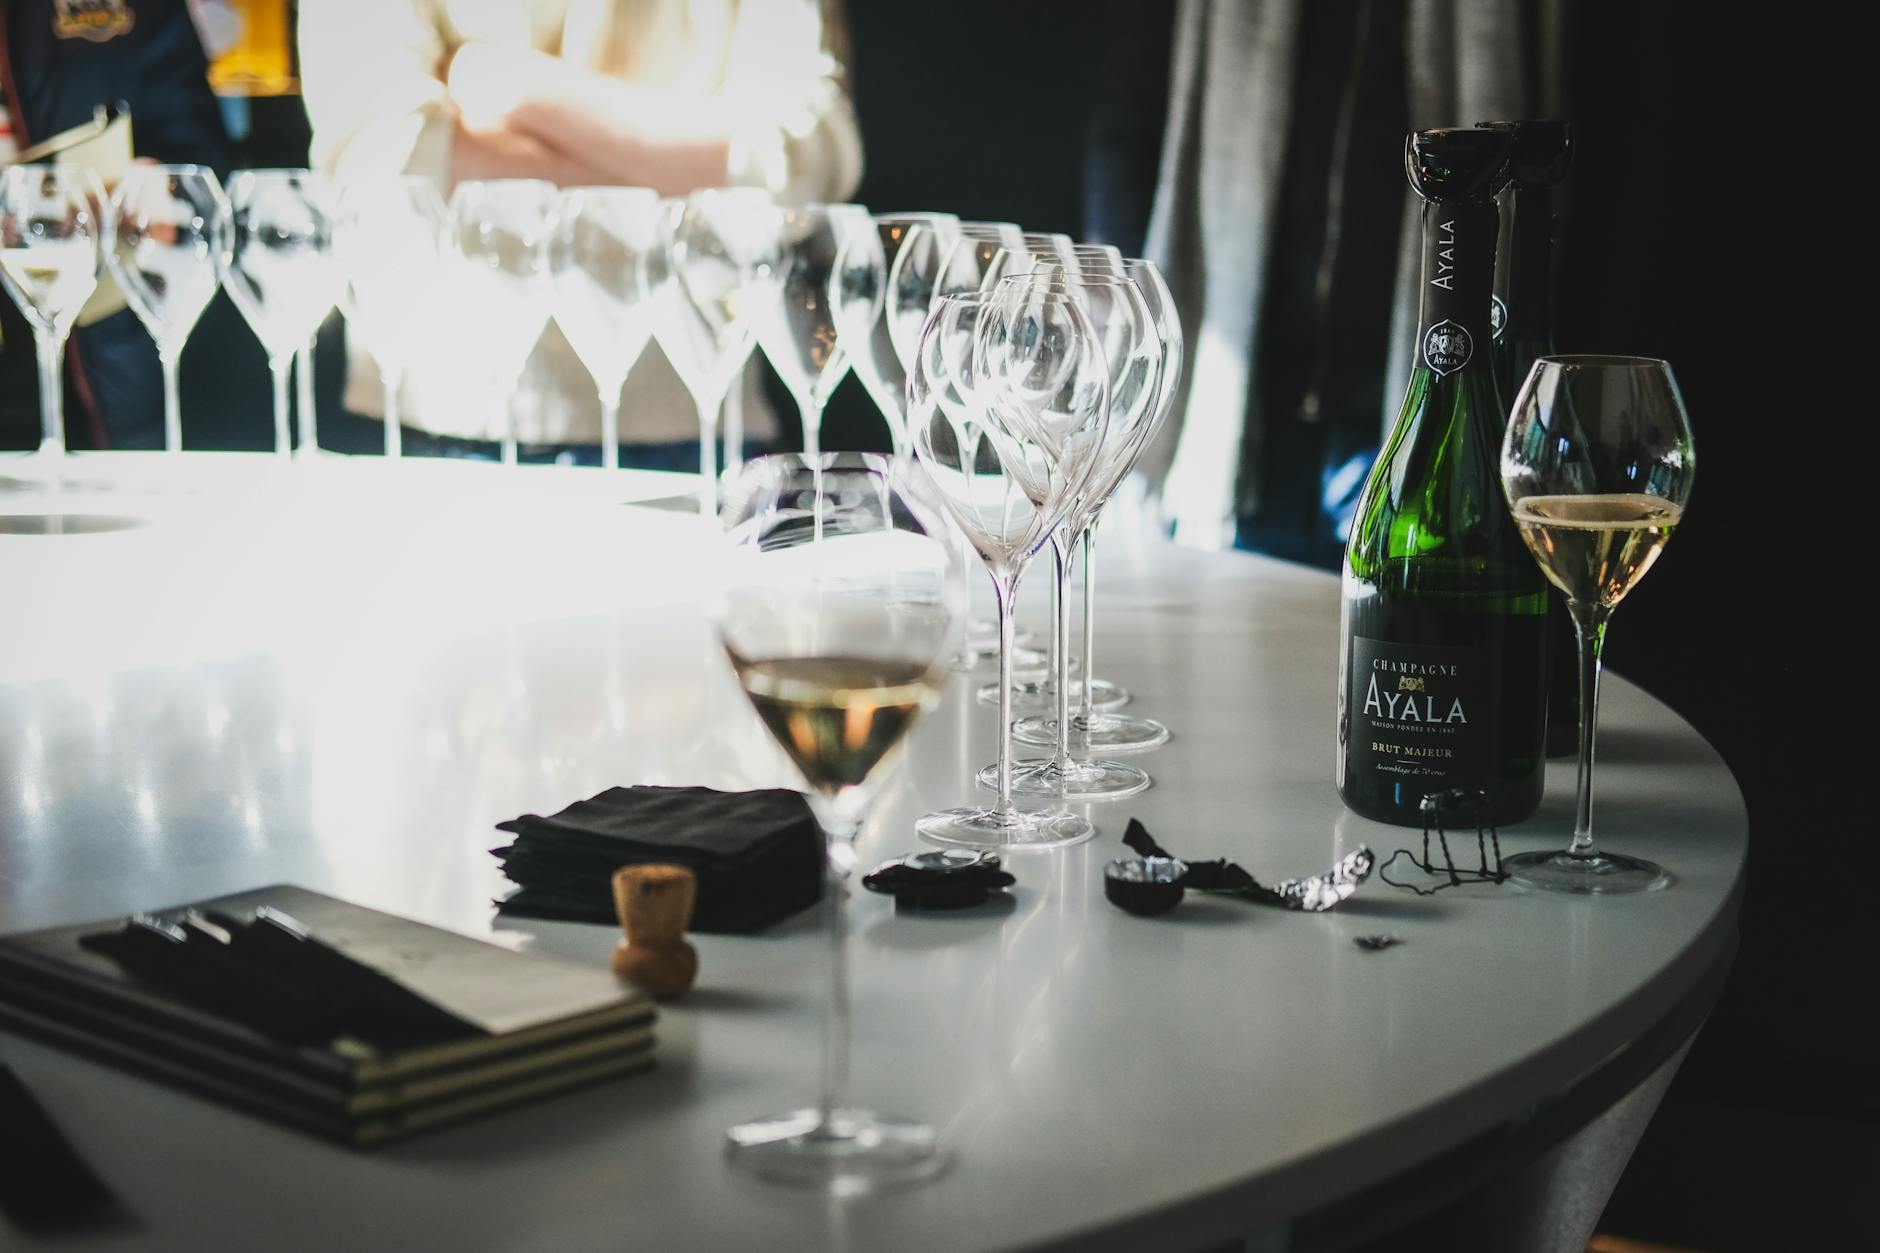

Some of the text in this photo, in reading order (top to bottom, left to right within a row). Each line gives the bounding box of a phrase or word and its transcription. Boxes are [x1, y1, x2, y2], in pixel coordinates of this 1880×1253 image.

[1430, 220, 1455, 290] AYALA
[1373, 658, 1457, 676] CHAMPAGNE
[1362, 671, 1467, 724] AYALA
[1371, 720, 1394, 729] MAISON
[1372, 741, 1452, 758] BRUT MAJEUR
[1375, 763, 1411, 775] Assemblage
